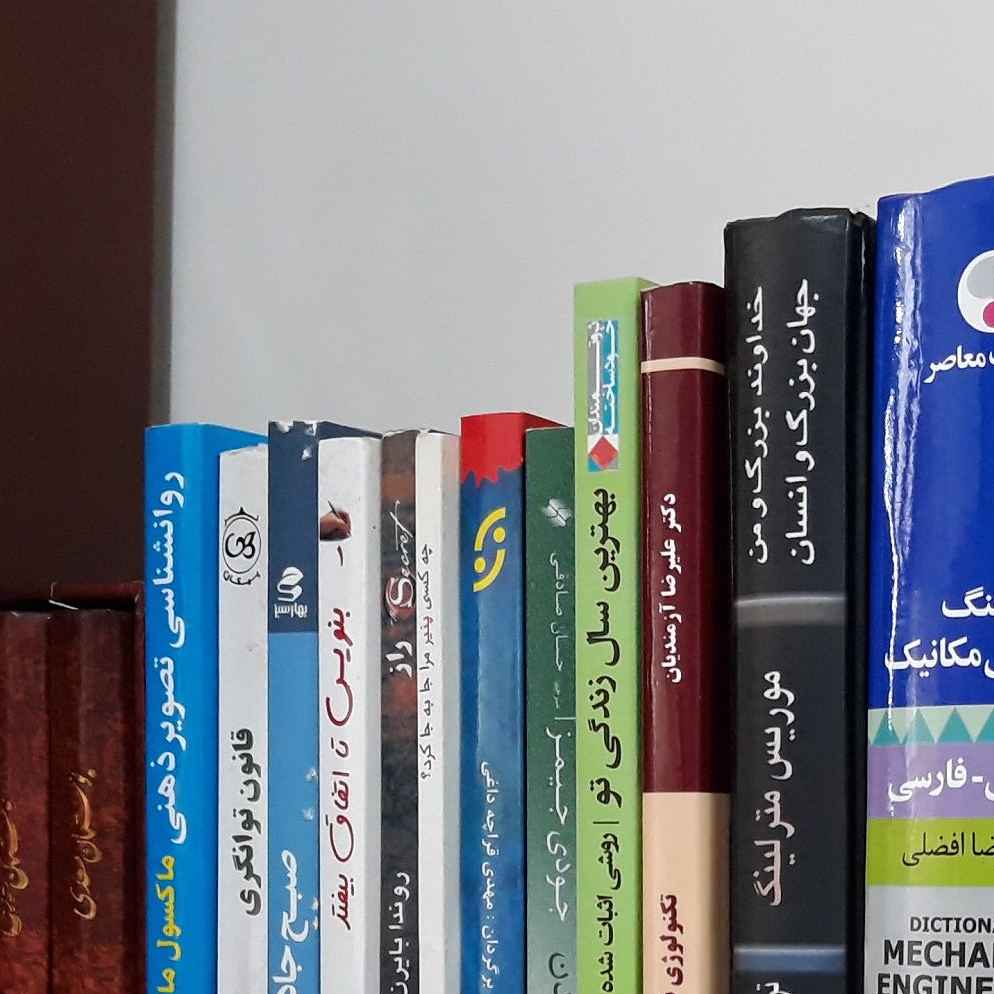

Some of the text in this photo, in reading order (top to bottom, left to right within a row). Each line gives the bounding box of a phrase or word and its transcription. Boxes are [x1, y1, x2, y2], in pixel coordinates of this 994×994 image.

[745, 286, 769, 396] خداوند
[786, 279, 820, 353] جهان
[923, 345, 986, 383] معاصر
[795, 451, 815, 470] و
[751, 497, 767, 518] و
[786, 476, 816, 565] انسان
[153, 472, 186, 648] روانشناسی
[385, 500, 415, 608] Secret
[420, 544, 433, 565] چه
[747, 524, 768, 564] من
[418, 570, 434, 609] کسی
[658, 493, 683, 684] دکتر علیرضا آزمندیان
[422, 615, 434, 645] پنیر
[586, 488, 621, 807] بهترین سال زندگی تو
[884, 636, 982, 678] مکانیک
[326, 607, 354, 727] بنویس
[385, 642, 413, 678] راز
[419, 652, 434, 670] مرا
[419, 677, 433, 692] جا
[153, 656, 188, 751] تصویر
[419, 722, 433, 736] جا
[422, 699, 434, 715] به
[329, 737, 351, 758] تا
[151, 751, 188, 844] ذهنی
[481, 761, 499, 803] داغی
[547, 728, 573, 826] جیمز
[753, 671, 796, 906] موریس مترلینگ
[231, 728, 262, 915] قانون توانگری
[326, 772, 353, 862] اتفاق
[481, 810, 500, 857] قراچه
[547, 831, 573, 921] جودی
[599, 833, 622, 890] روشی
[902, 831, 965, 867] افضلی
[157, 856, 183, 961] ماکسول
[280, 849, 310, 943] صبح
[390, 872, 411, 931] روندا
[481, 863, 499, 911] مهدی
[596, 895, 615, 946] اثبات
[659, 895, 684, 987] تکنولوژی
[597, 952, 615, 992] شده
